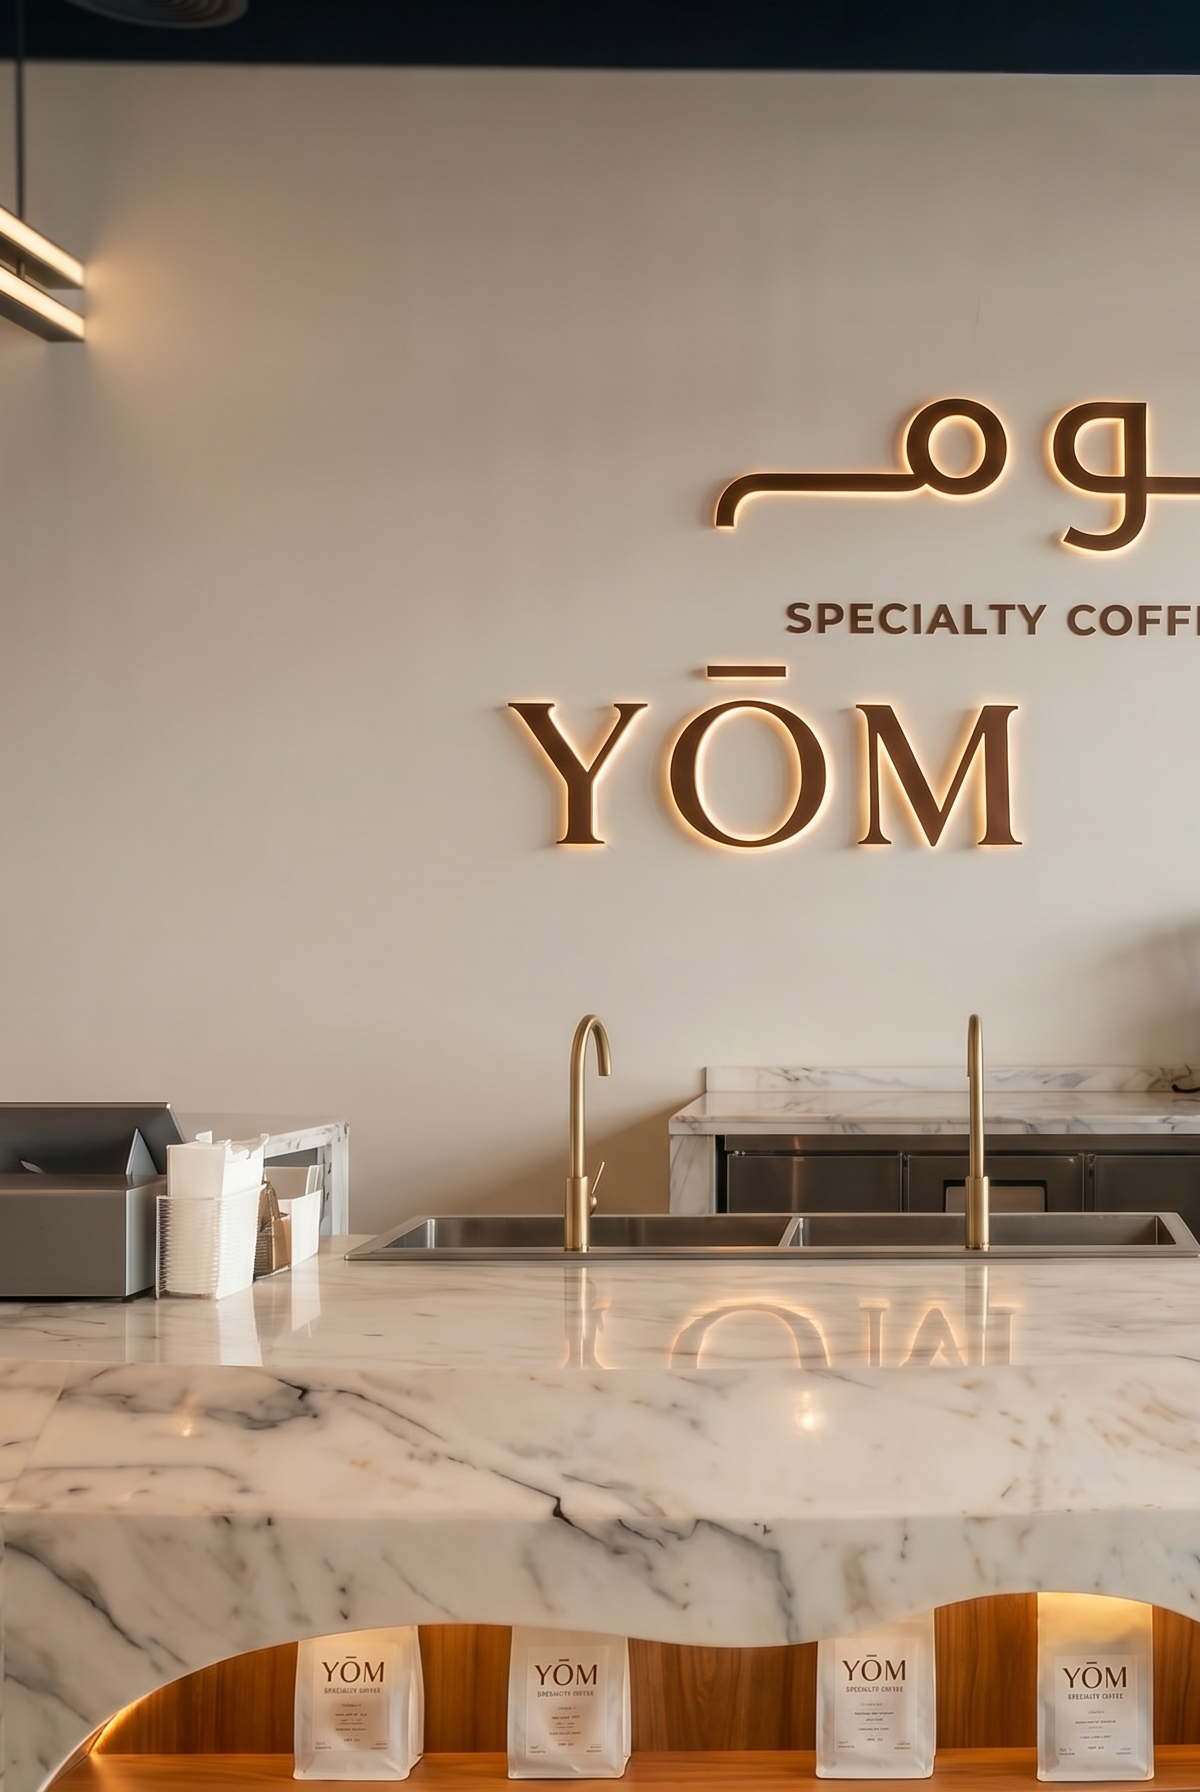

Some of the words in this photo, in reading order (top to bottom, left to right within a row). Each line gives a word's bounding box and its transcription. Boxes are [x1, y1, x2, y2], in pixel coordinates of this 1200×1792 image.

[785, 601, 1047, 636] SPECIALTY
[507, 665, 1023, 848] YŌM
[322, 1655, 385, 1683] YŌM
[535, 1658, 598, 1686] YŌM
[842, 1654, 906, 1682] YŌM
[1062, 1661, 1127, 1689] YŌM
